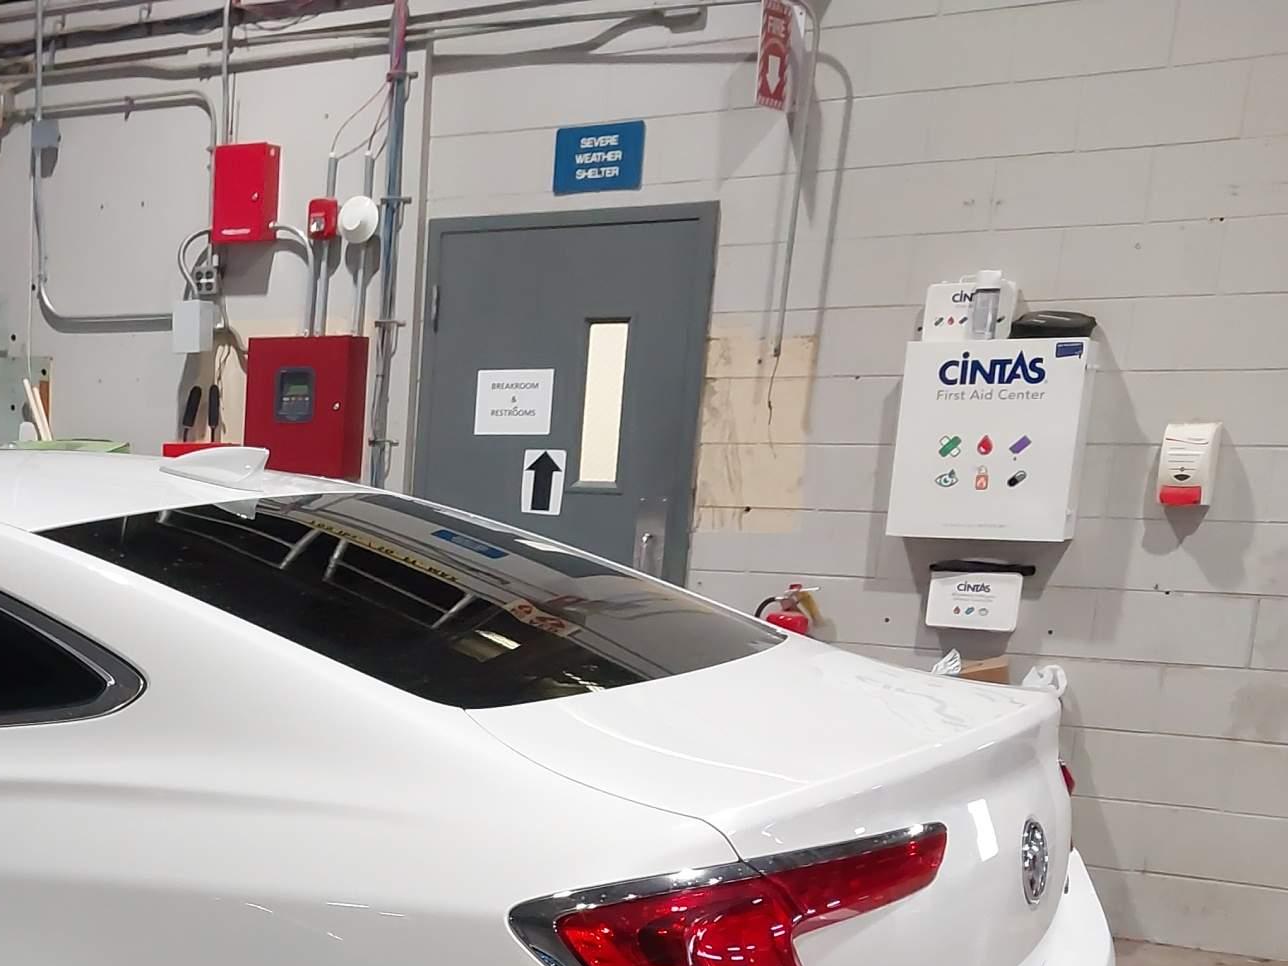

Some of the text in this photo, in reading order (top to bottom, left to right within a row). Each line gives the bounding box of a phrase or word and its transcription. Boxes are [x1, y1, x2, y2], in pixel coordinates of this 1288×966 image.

[580, 134, 620, 149] SEVERE
[575, 150, 623, 164] WEATHER
[575, 166, 620, 180] SHELTER
[491, 382, 540, 390] BREAKROOM
[936, 388, 1046, 401] First Aid Center
[490, 409, 537, 417] RESTROOMS
